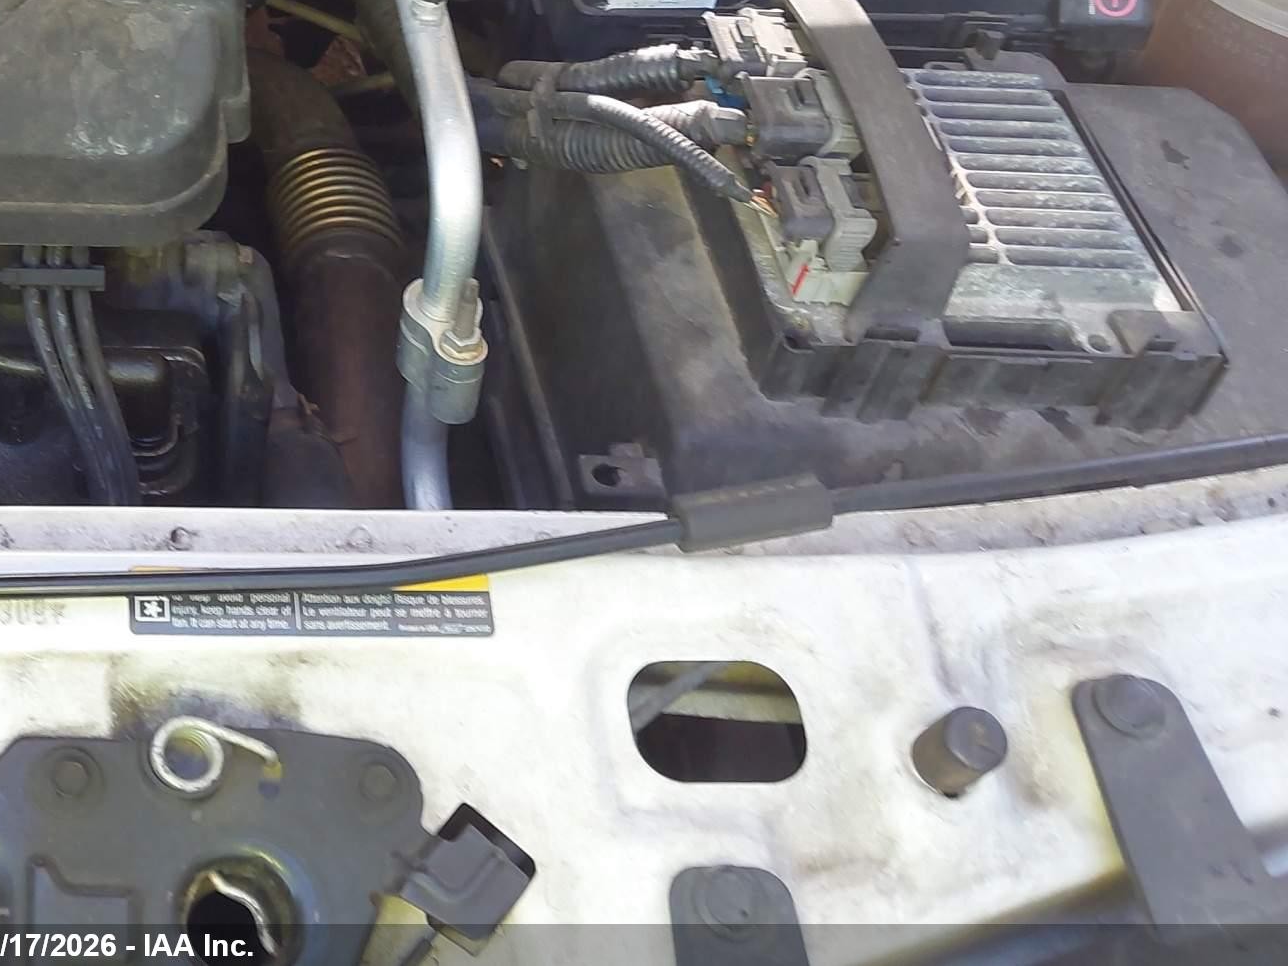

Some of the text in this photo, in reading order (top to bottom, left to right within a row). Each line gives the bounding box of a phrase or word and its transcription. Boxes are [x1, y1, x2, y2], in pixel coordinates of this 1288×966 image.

[249, 592, 291, 604] personal
[301, 593, 342, 604] Attention
[200, 604, 225, 617] keep
[225, 605, 256, 616] hands
[256, 605, 279, 616] clear
[280, 605, 292, 617] of
[302, 605, 316, 617] Le
[318, 606, 367, 617] ventilateur
[369, 607, 393, 619] peut
[198, 619, 216, 628] can
[216, 618, 238, 629] start
[238, 618, 250, 629] at
[249, 620, 267, 631] any
[303, 620, 327, 630] sans
